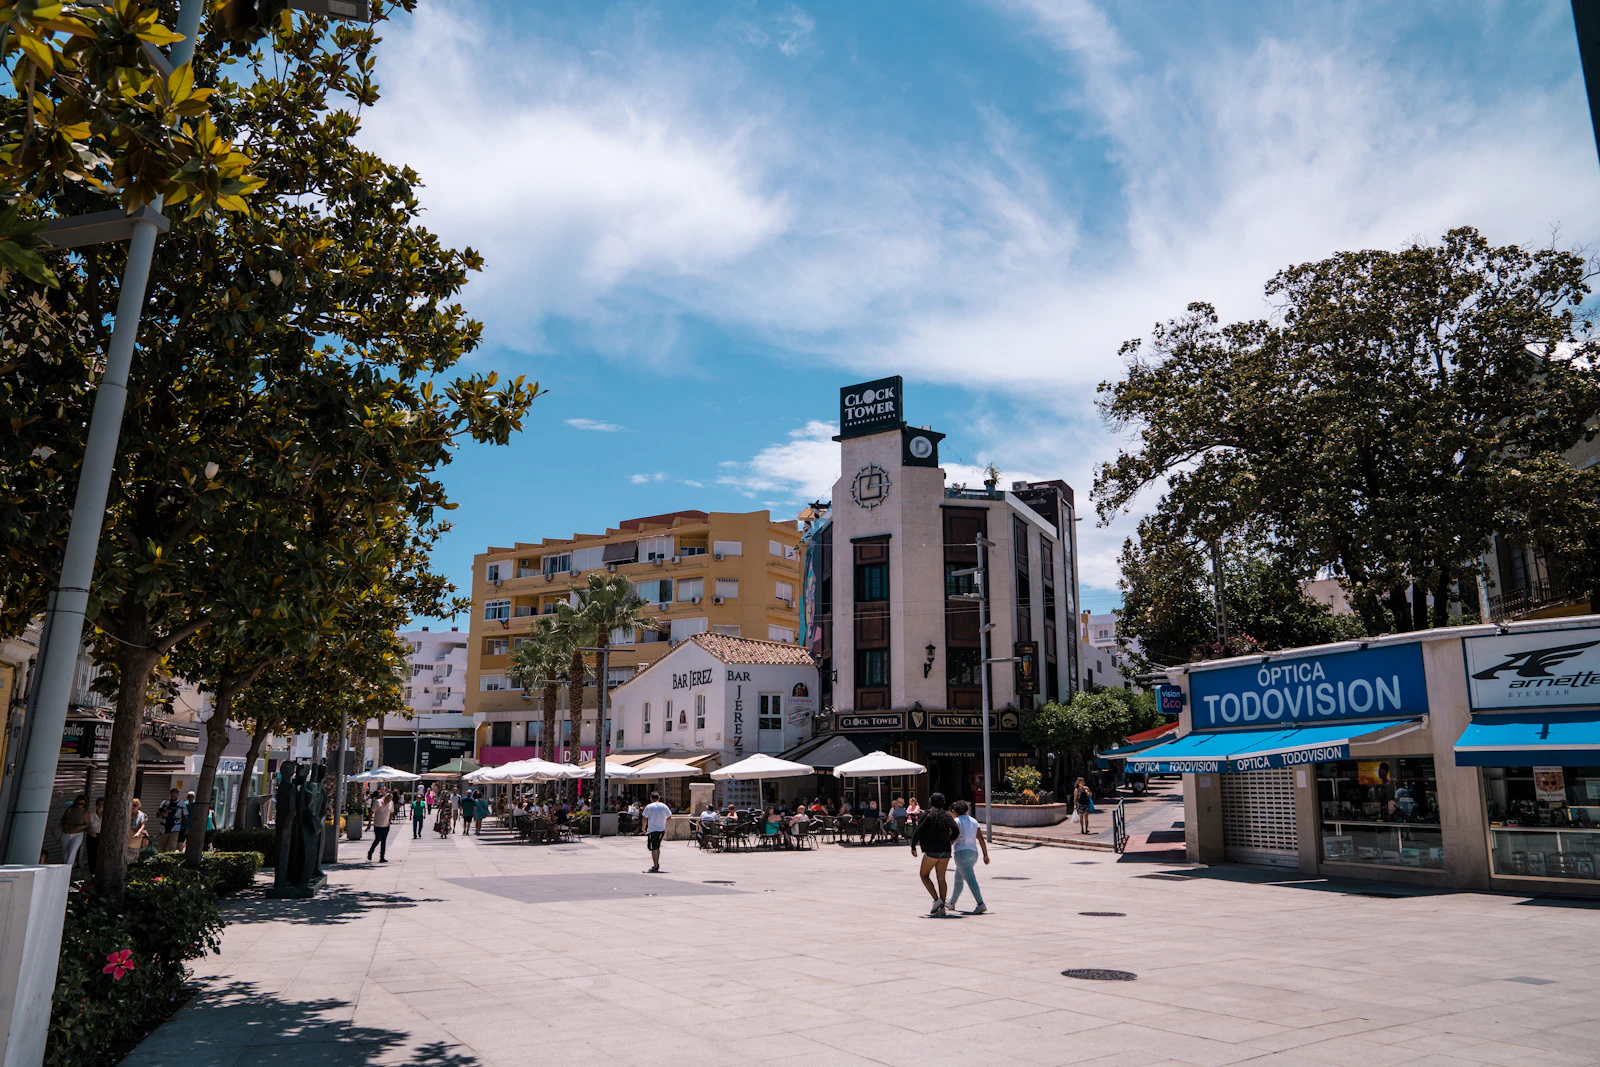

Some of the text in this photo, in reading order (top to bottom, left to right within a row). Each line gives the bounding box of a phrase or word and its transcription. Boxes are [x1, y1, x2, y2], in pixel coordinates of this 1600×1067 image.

[844, 387, 895, 407] CLOCK
[844, 401, 895, 420] TOWER
[845, 413, 896, 427] TORREMOLINOS
[672, 668, 713, 691] BAR JEREZ
[727, 670, 752, 681] BAR
[1257, 661, 1326, 687] ÓPTICA
[1162, 690, 1181, 698] vision
[1203, 674, 1402, 724] TODOVISION
[1508, 689, 1570, 698] EYEWEAR
[1162, 698, 1181, 708] &co
[733, 684, 744, 747] JEREZ
[843, 717, 898, 726] CLOCK TOWER
[937, 717, 983, 725] MUSIC BA
[63, 723, 84, 736] oviles
[1237, 746, 1342, 771] OPTICA TODOVISION
[1134, 761, 1218, 772] OPTICA TODOVISION
